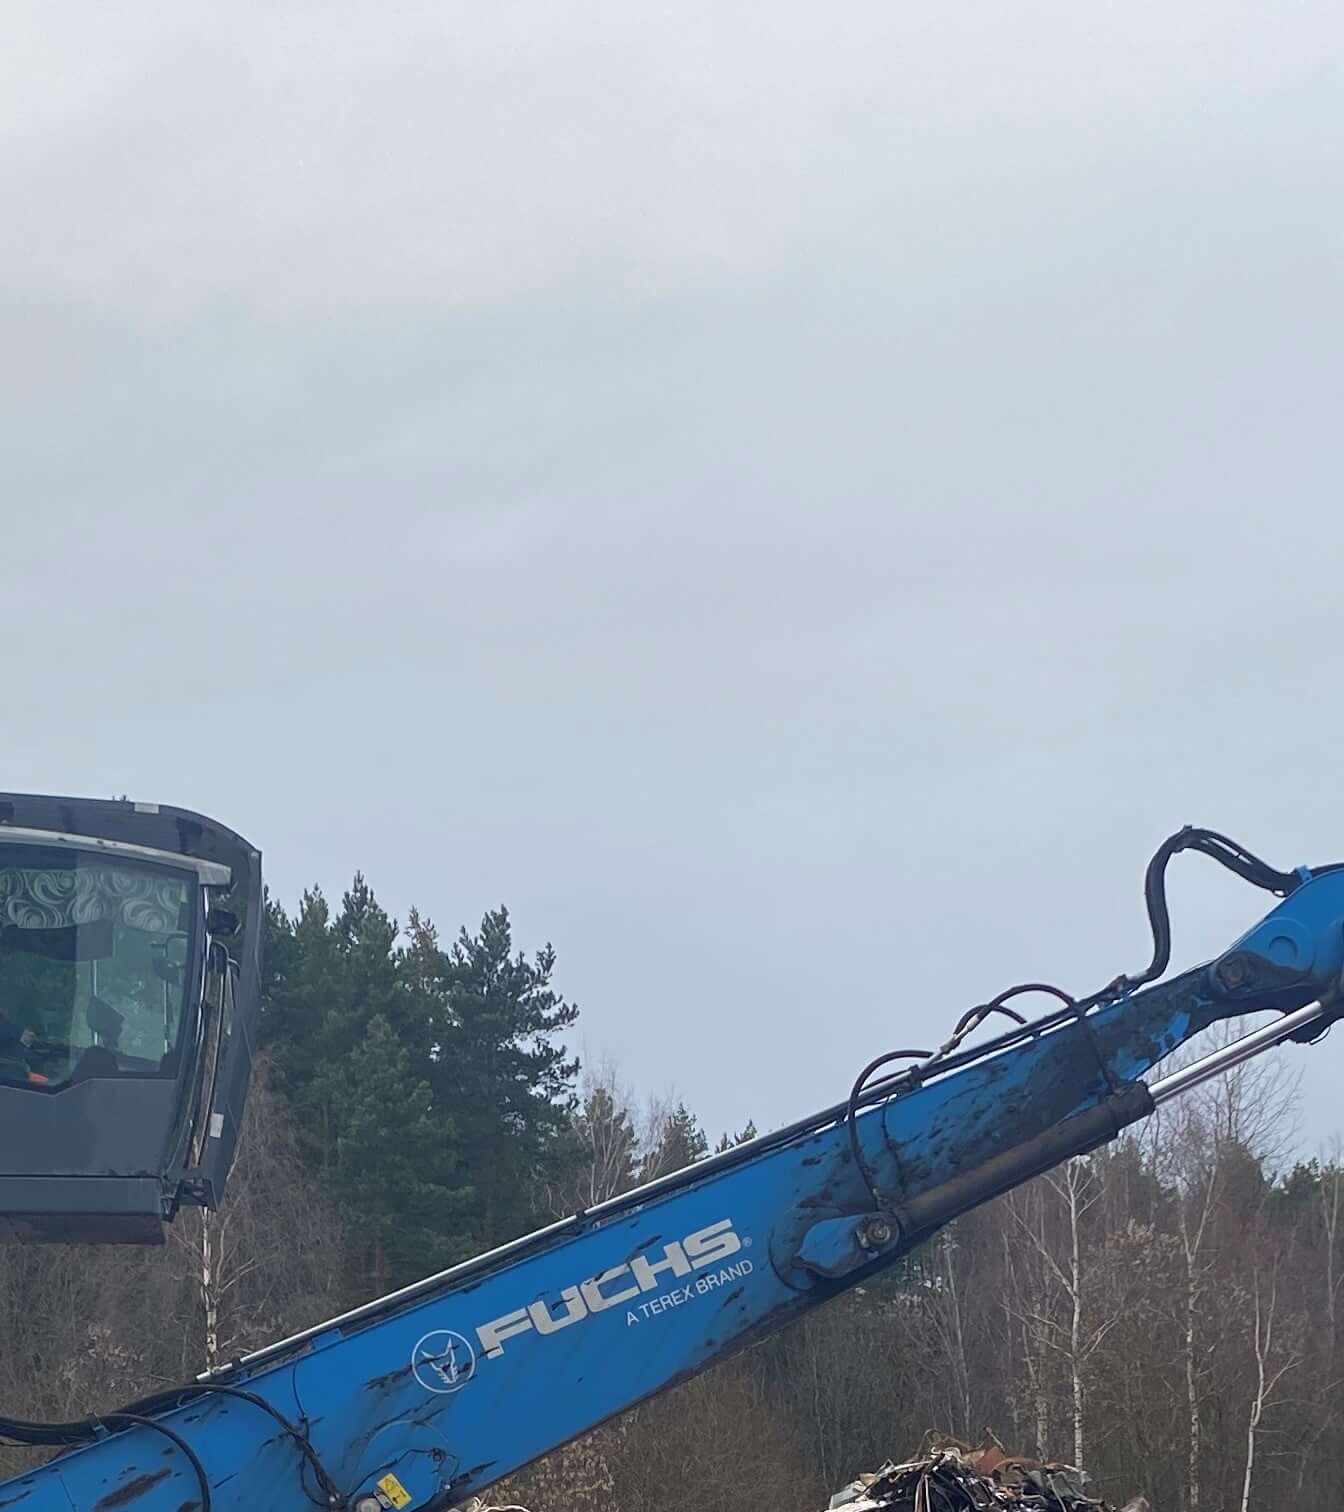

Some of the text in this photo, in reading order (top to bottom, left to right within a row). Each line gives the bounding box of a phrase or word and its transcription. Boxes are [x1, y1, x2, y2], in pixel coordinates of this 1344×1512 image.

[476, 1218, 742, 1360] FUCHS
[625, 1259, 754, 1327] A TEREX BRAND
